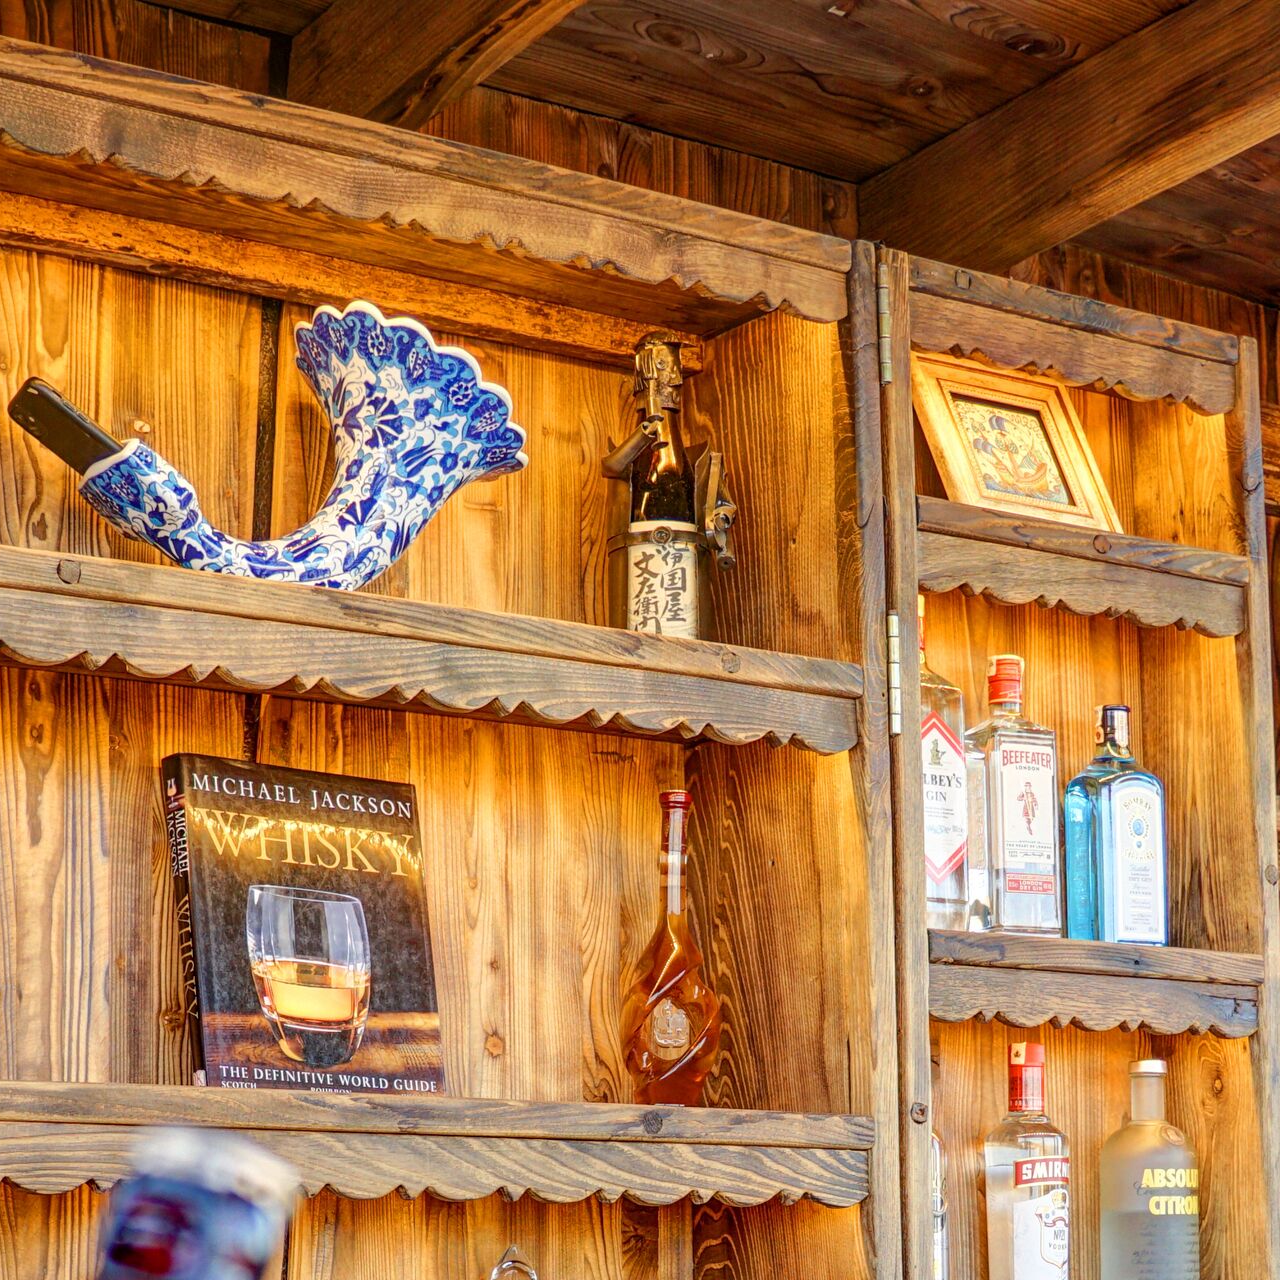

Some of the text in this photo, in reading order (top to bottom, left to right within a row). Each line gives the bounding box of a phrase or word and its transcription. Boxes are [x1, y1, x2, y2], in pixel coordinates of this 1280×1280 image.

[1002, 749, 1052, 770] BEEFEATER
[1015, 764, 1041, 772] LONDON
[923, 772, 963, 789] LBEY'S
[191, 772, 412, 819] MICHAEL JACKSON
[926, 790, 947, 803] GIN
[167, 811, 179, 878] JACKSON
[173, 808, 190, 878] MICHAEL
[194, 807, 415, 877] WHISKY
[175, 894, 200, 1020] WHISKY
[219, 1065, 438, 1093] THE DEFINITIVE WORLD GUIDE
[220, 1080, 257, 1089] SCOTCH
[1022, 1161, 1069, 1180] SMIRN
